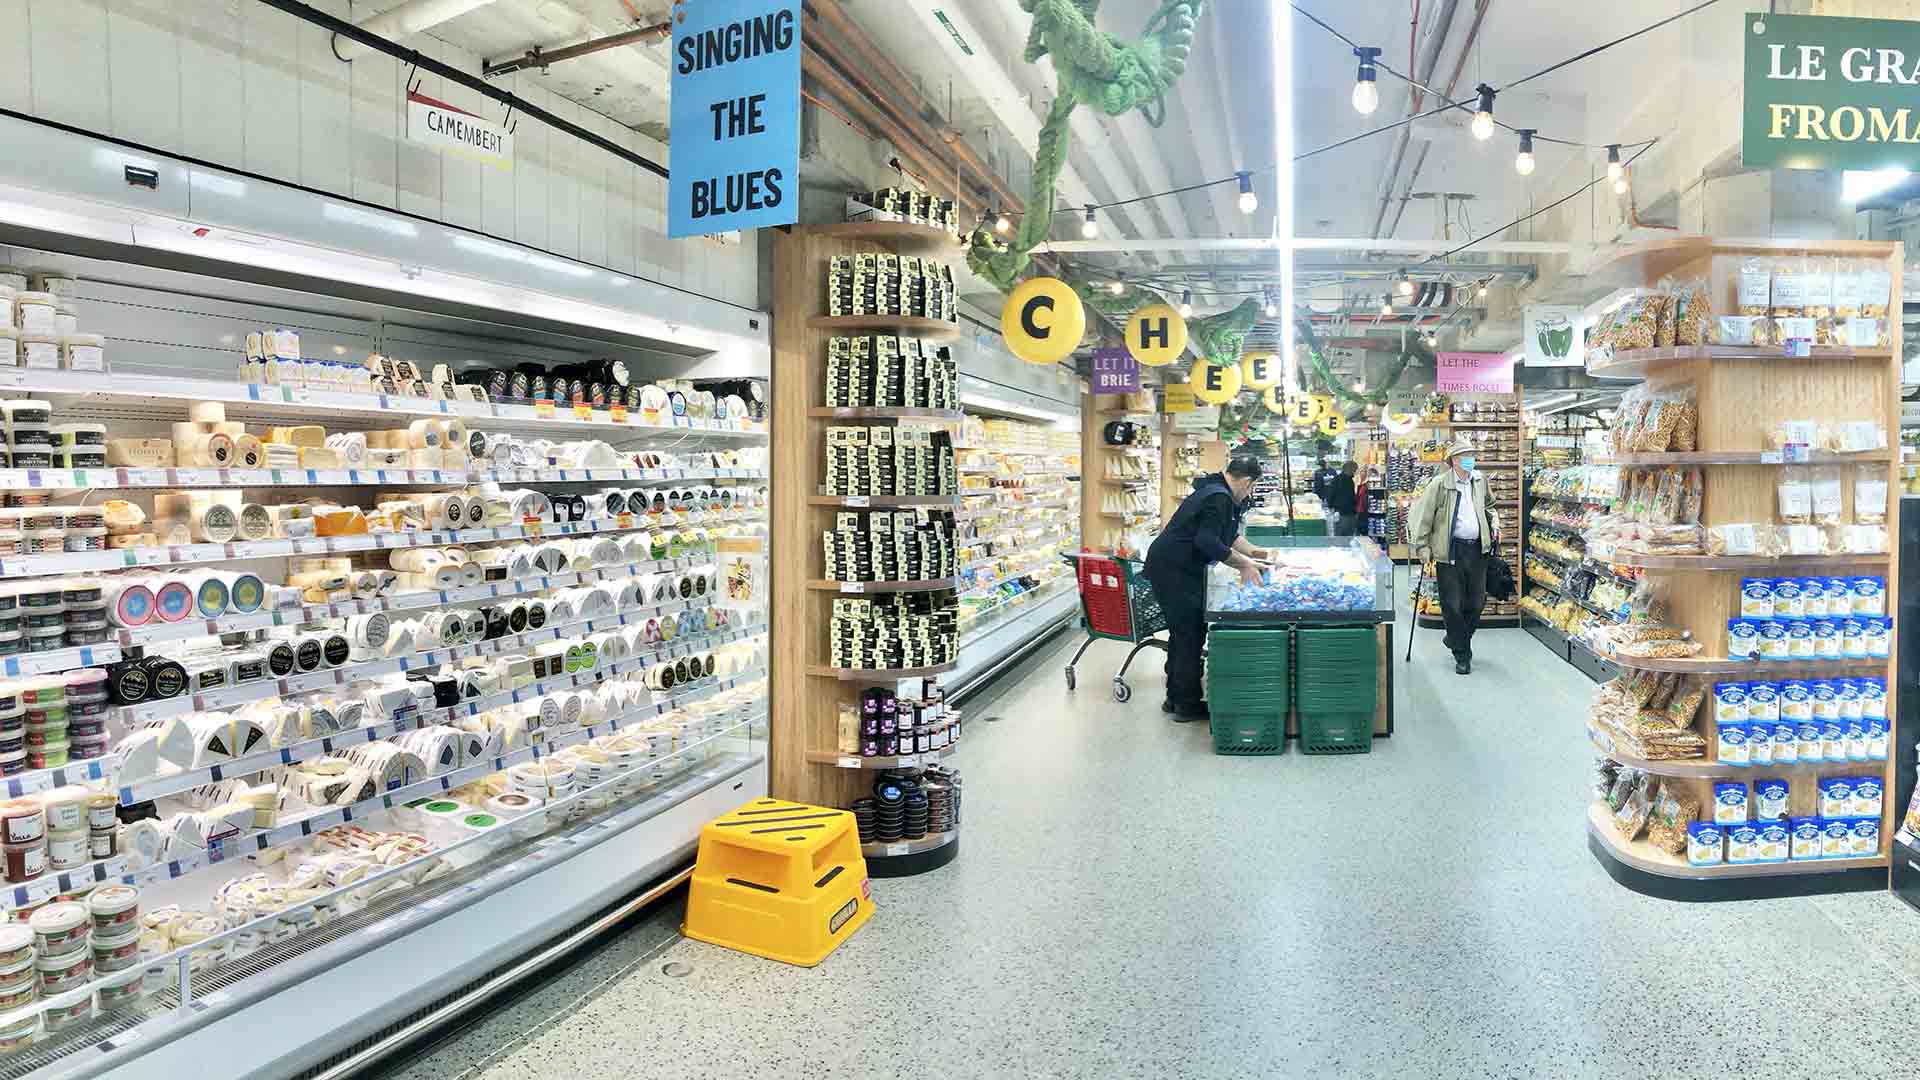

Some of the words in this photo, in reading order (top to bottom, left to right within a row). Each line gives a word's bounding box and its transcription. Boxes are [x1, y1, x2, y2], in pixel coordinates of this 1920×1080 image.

[677, 9, 793, 75] SINGING
[1767, 44, 1826, 81] LE
[427, 111, 502, 153] CAMEMBERT
[710, 94, 766, 141] THE
[1767, 103, 1920, 143] FROM
[691, 168, 783, 219] BLUES
[1021, 295, 1055, 339] C
[1140, 317, 1169, 349] H
[1206, 365, 1223, 391] E
[1094, 358, 1119, 370] LET
[1100, 374, 1131, 386] BRIE
[1442, 359, 1459, 368] LET
[1461, 359, 1480, 368] THE
[1443, 383, 1472, 392] TIMES
